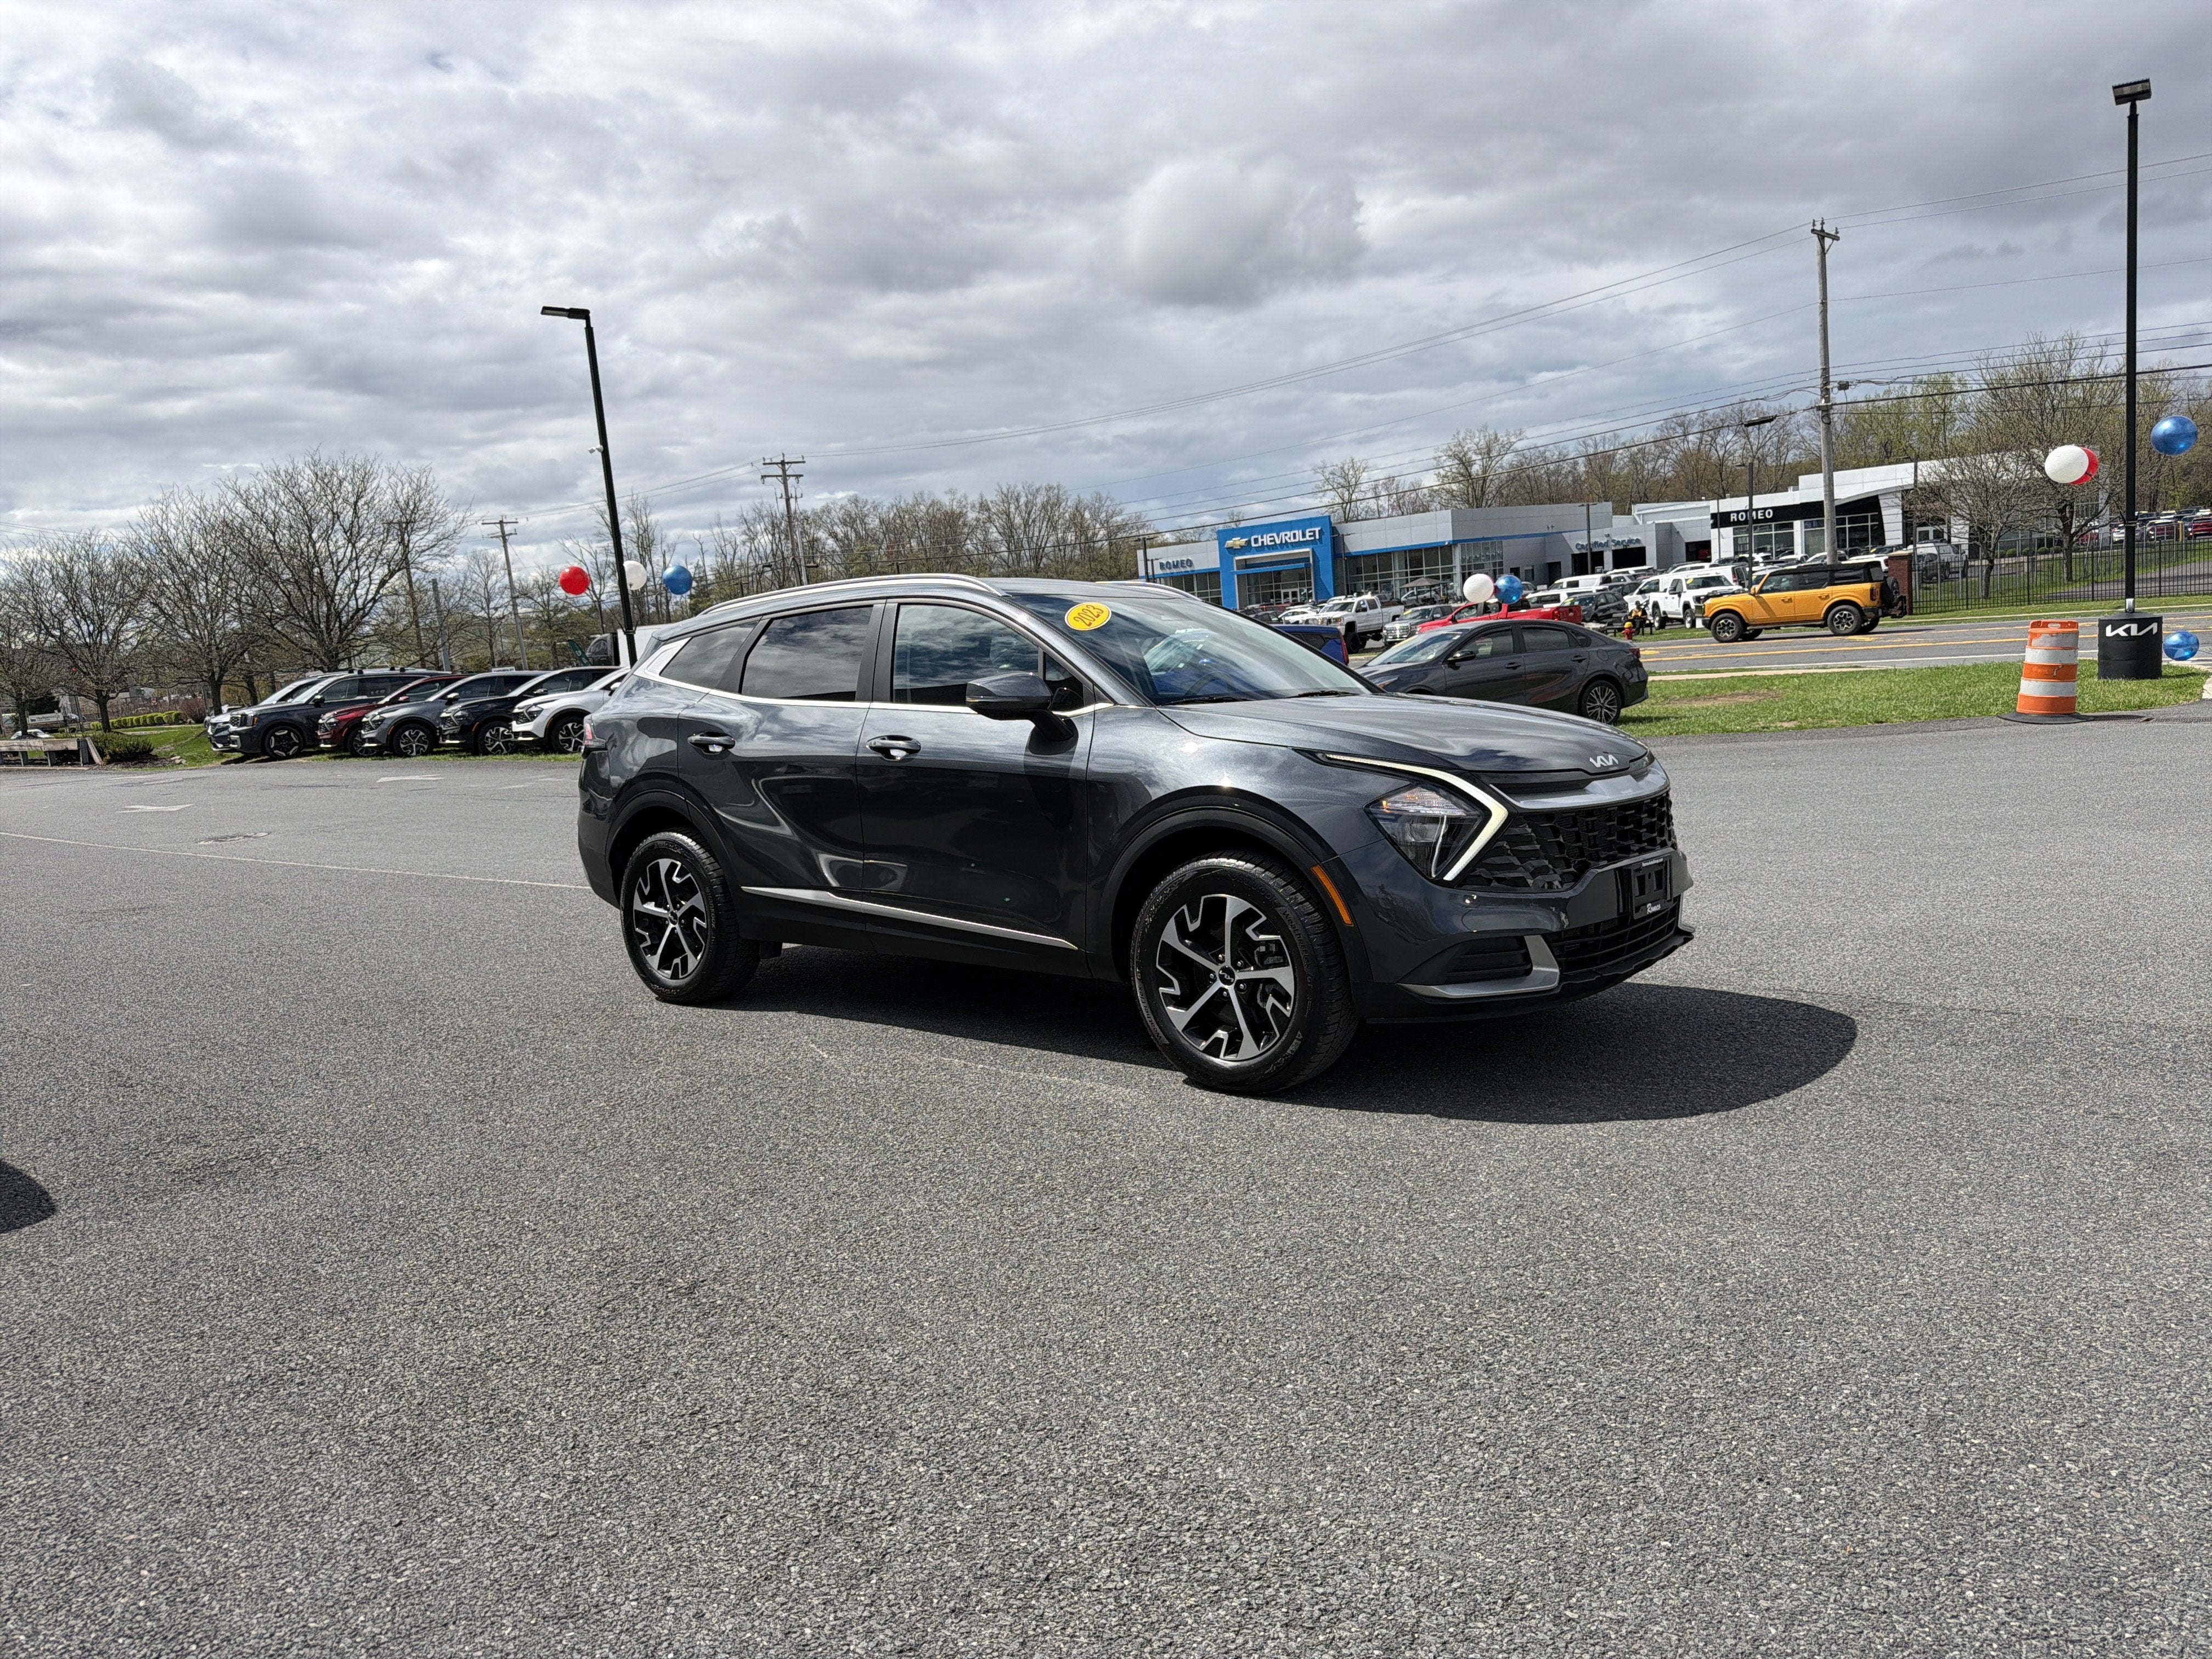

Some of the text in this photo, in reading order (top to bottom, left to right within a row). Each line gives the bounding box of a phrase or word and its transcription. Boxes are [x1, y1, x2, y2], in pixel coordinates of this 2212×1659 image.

[1730, 509, 1773, 522] ROMEO
[1251, 527, 1321, 547] CHEVROLET
[1576, 538, 1641, 551] Cerified Service
[1159, 558, 1193, 571] ROMEO
[1073, 605, 1104, 627] 2023
[2106, 623, 2158, 637] KIA
[1589, 754, 1619, 768] KIA
